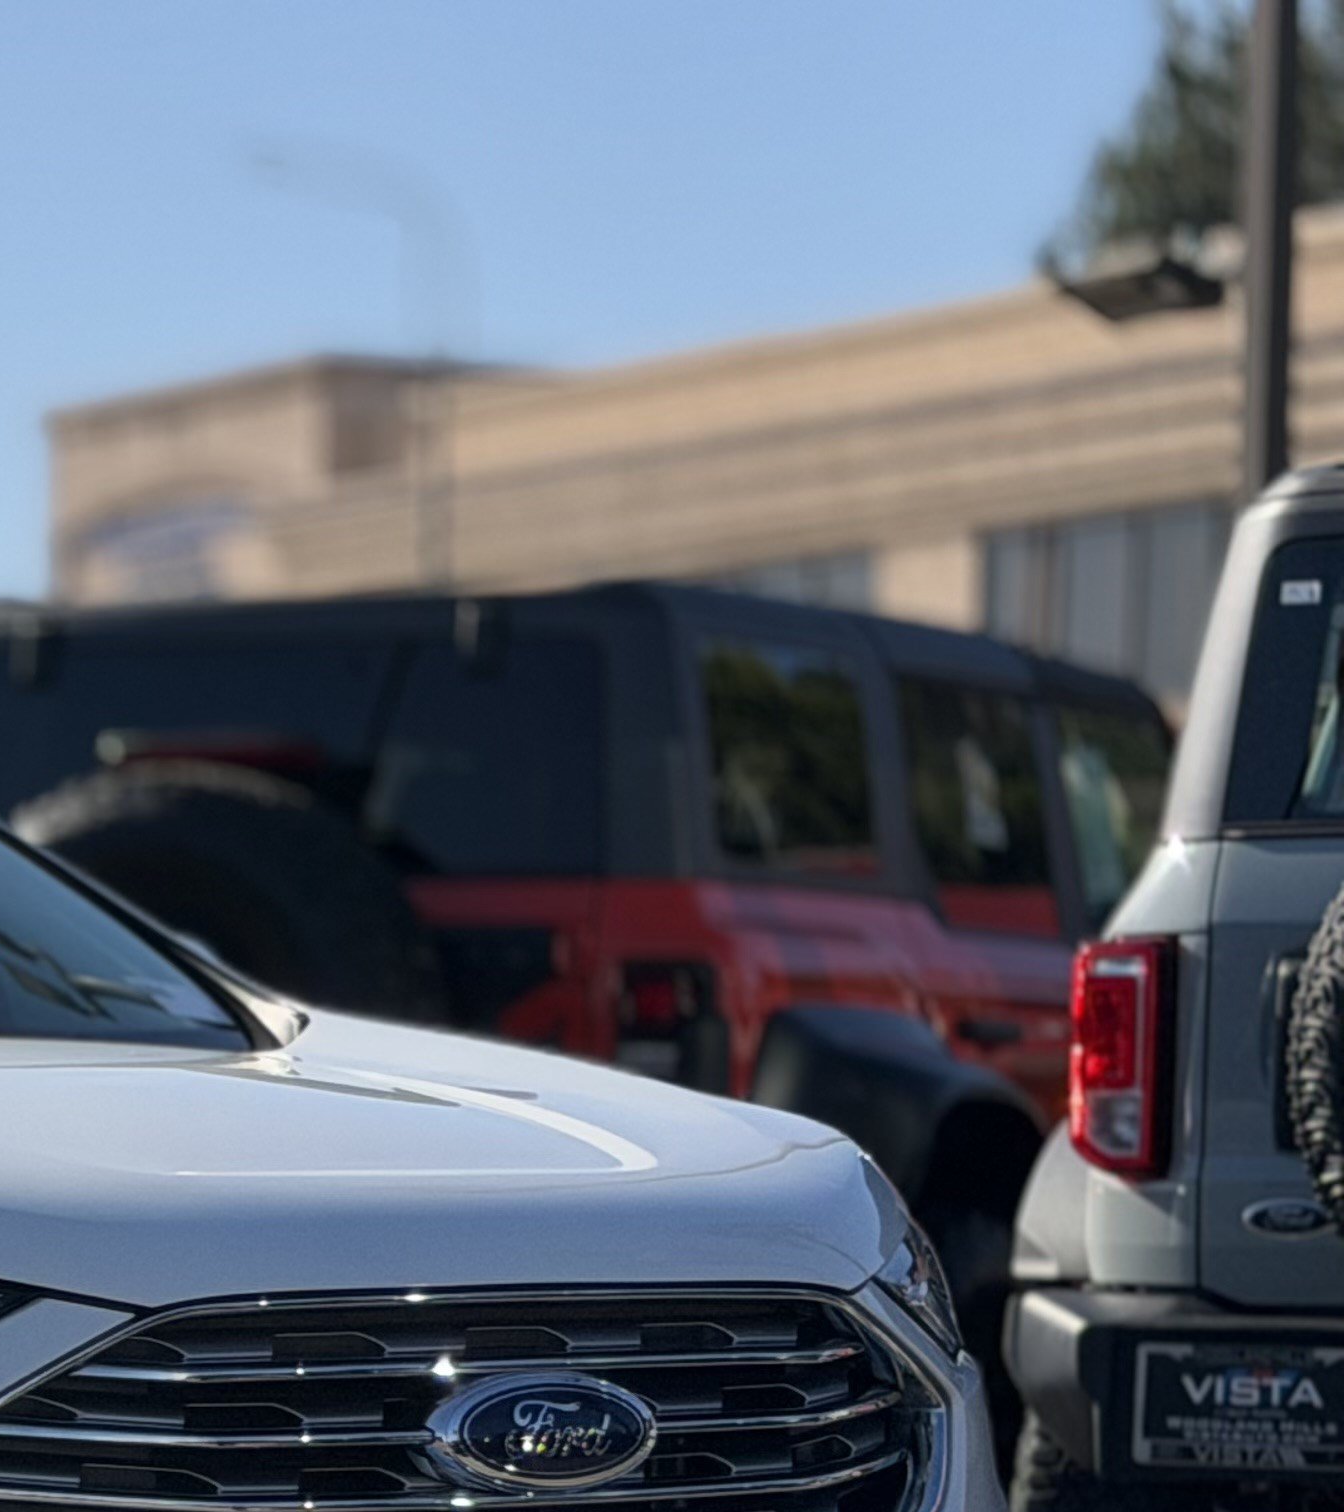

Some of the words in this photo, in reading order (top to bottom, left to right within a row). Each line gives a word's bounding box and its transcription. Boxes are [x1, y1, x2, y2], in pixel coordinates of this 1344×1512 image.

[1180, 1373, 1324, 1410] VISTA
[504, 1400, 613, 1460] Ford
[1192, 1446, 1281, 1467] VISTA
